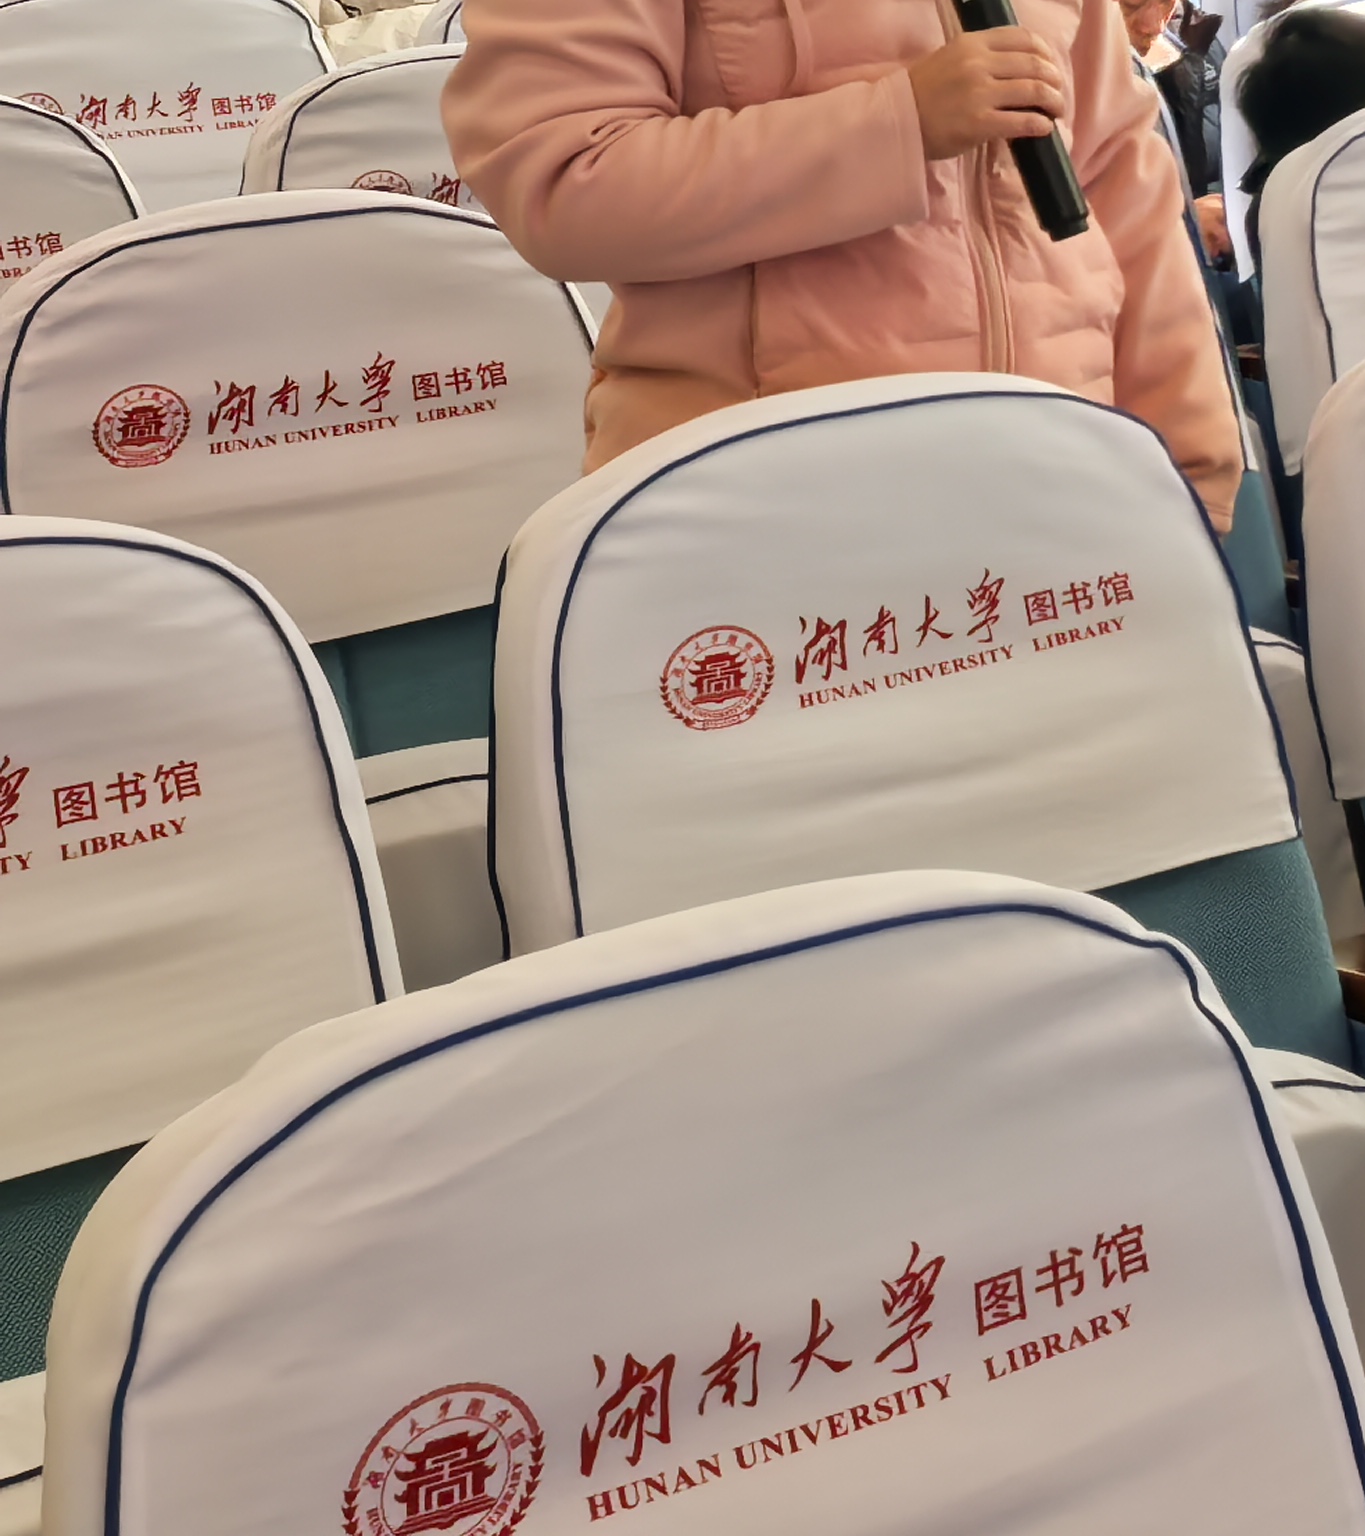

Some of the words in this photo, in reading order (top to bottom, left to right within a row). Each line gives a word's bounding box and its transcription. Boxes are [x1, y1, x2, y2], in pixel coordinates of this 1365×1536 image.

[127, 124, 205, 138] UNIVERSITY
[215, 118, 260, 131] LIBRA
[211, 92, 277, 116] 图书馆
[0, 231, 64, 261] 书馆
[411, 359, 508, 402] 图书馆
[208, 433, 278, 455] HUNAN
[284, 415, 400, 445] UNIVERSITY
[416, 398, 498, 424] LIBRARY
[1024, 571, 1134, 626] 图书馆
[799, 678, 876, 709] HUNAN
[884, 644, 1014, 689] UNIVERSITY
[1032, 616, 1126, 652] LIBRARY
[52, 760, 202, 829] 图书馆
[60, 816, 187, 862] LIBRARY
[974, 1223, 1150, 1336] 图书馆
[588, 1454, 723, 1521] HUNAN
[732, 1373, 954, 1470] UNIVERSITY
[985, 1303, 1134, 1381] LIBRARY
